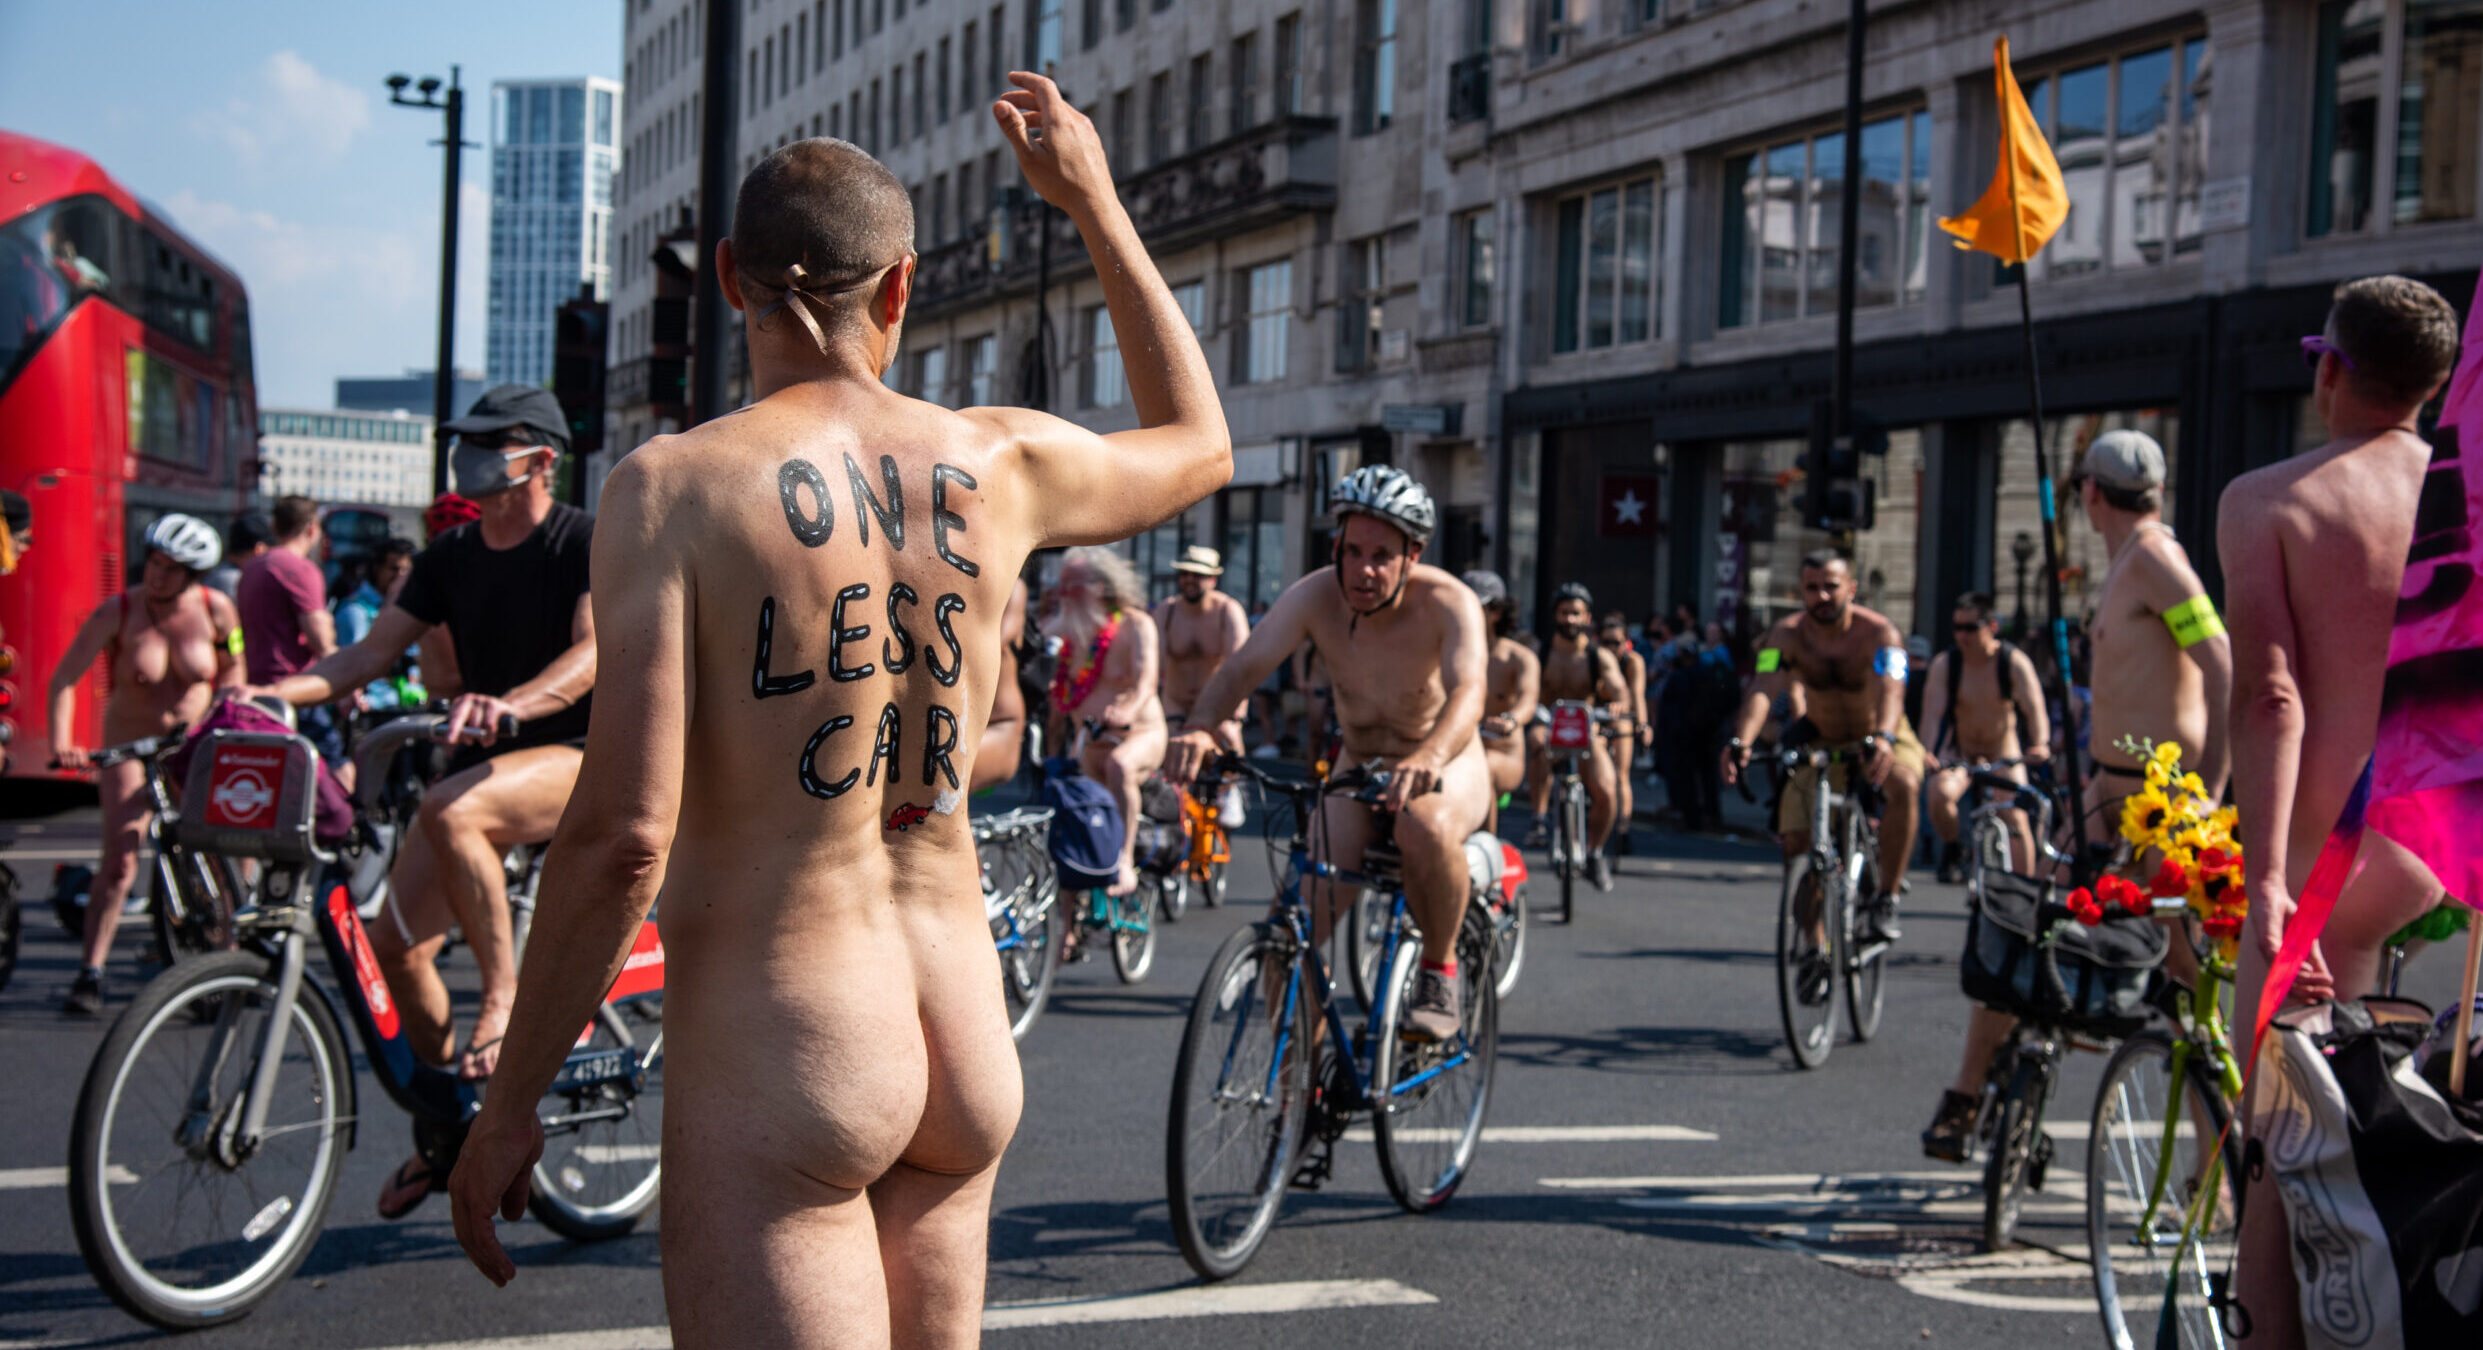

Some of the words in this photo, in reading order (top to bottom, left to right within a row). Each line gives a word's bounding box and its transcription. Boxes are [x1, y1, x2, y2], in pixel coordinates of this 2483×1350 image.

[778, 451, 981, 578] ONE
[752, 582, 967, 699] LESS
[798, 701, 960, 800] CAR
